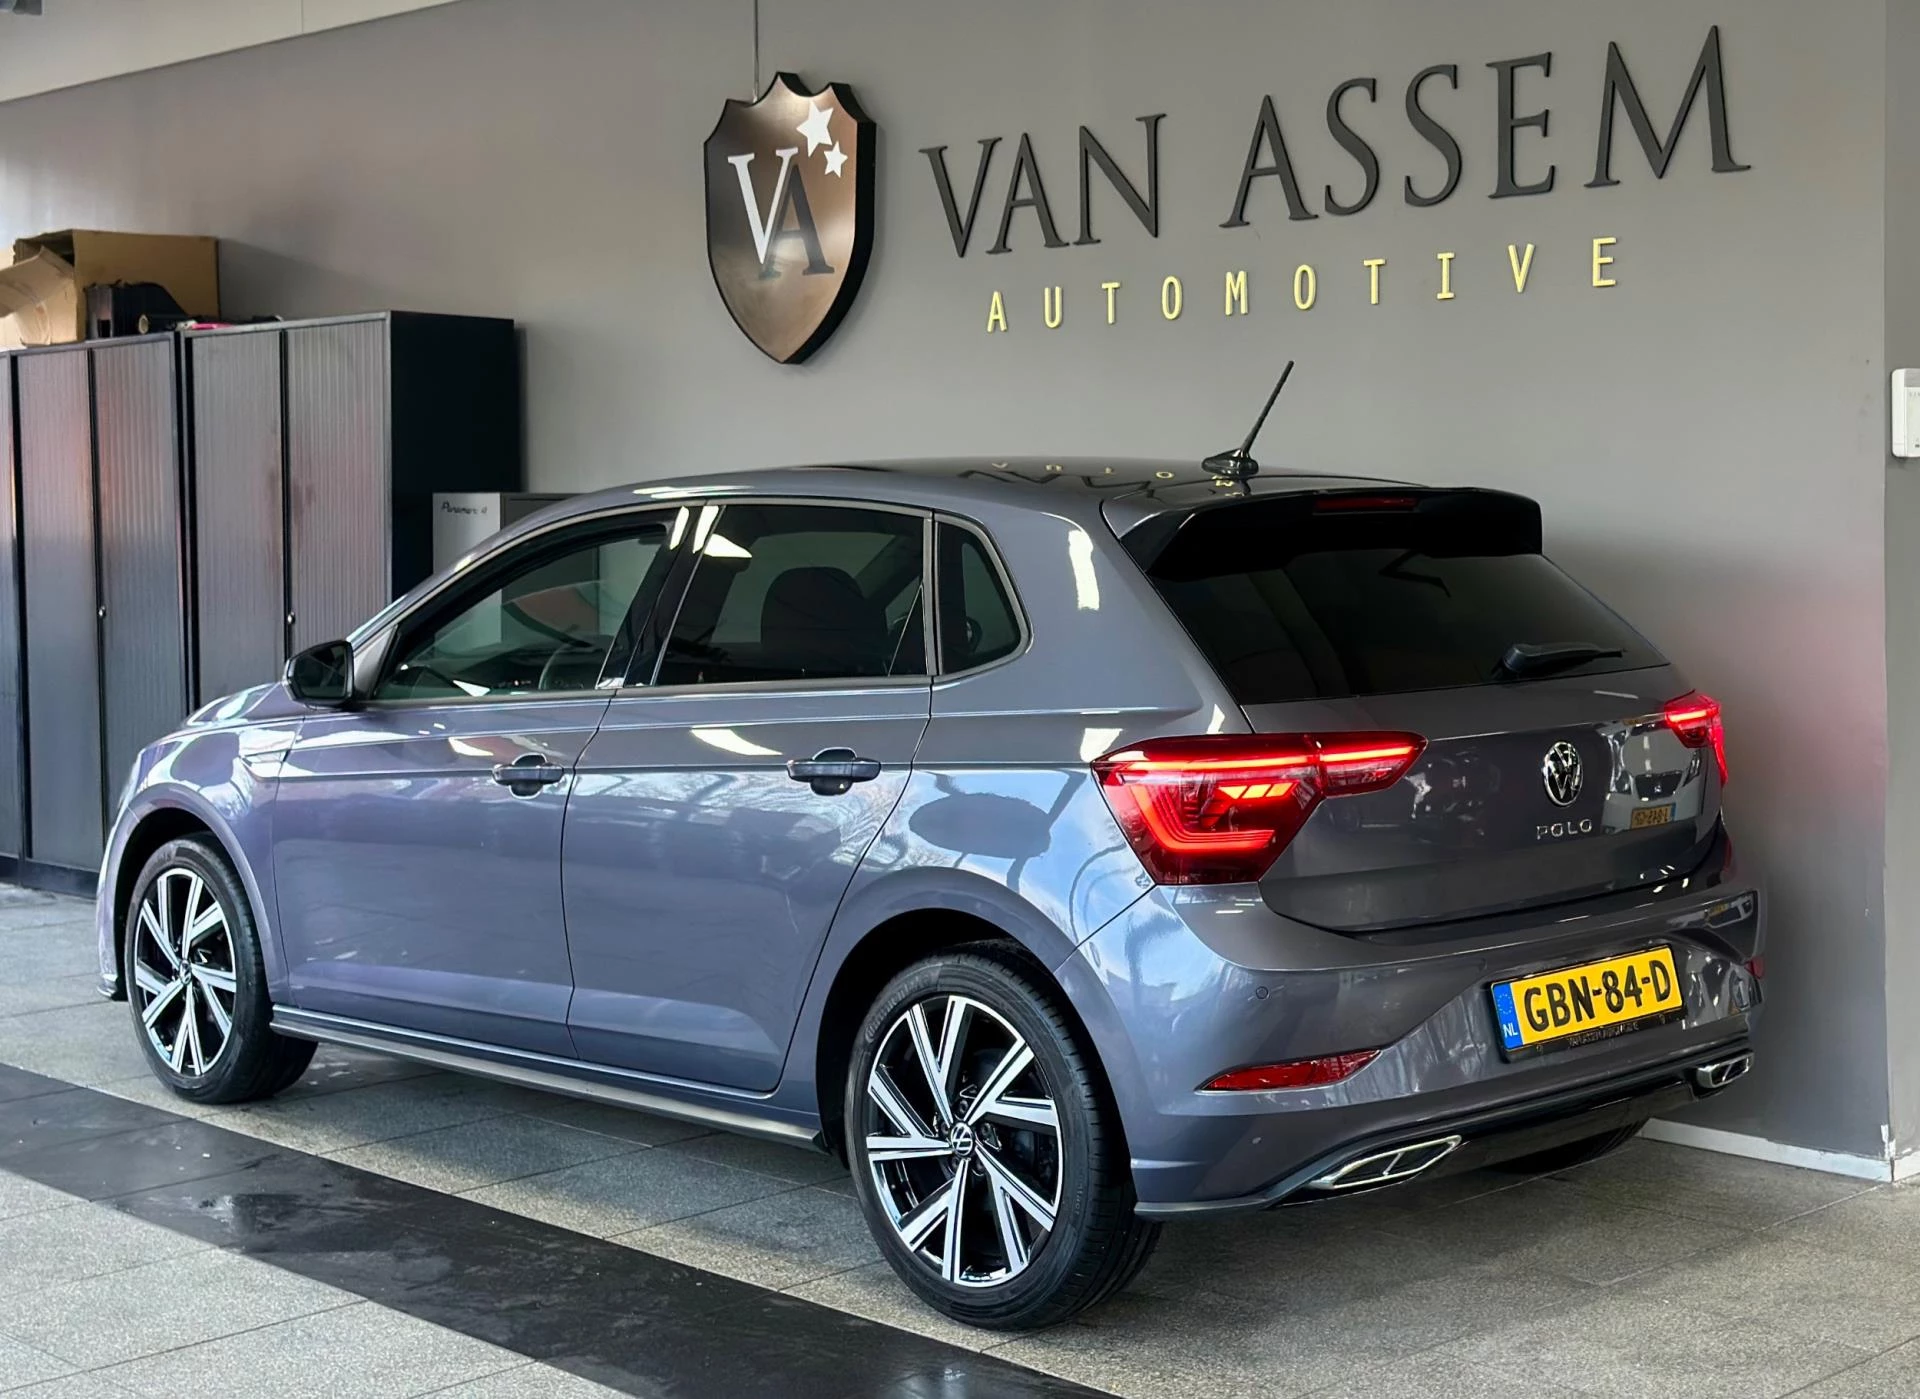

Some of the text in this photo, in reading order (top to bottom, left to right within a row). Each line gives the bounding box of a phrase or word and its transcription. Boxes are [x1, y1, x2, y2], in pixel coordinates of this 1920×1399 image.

[919, 25, 1752, 258] VAN ASSEM
[727, 147, 835, 279] VA
[986, 237, 1617, 333] AUTOMOTIVE
[1536, 818, 1592, 840] POLO
[1502, 1021, 1518, 1038] NL
[1523, 959, 1671, 1032] GBN-84-D
